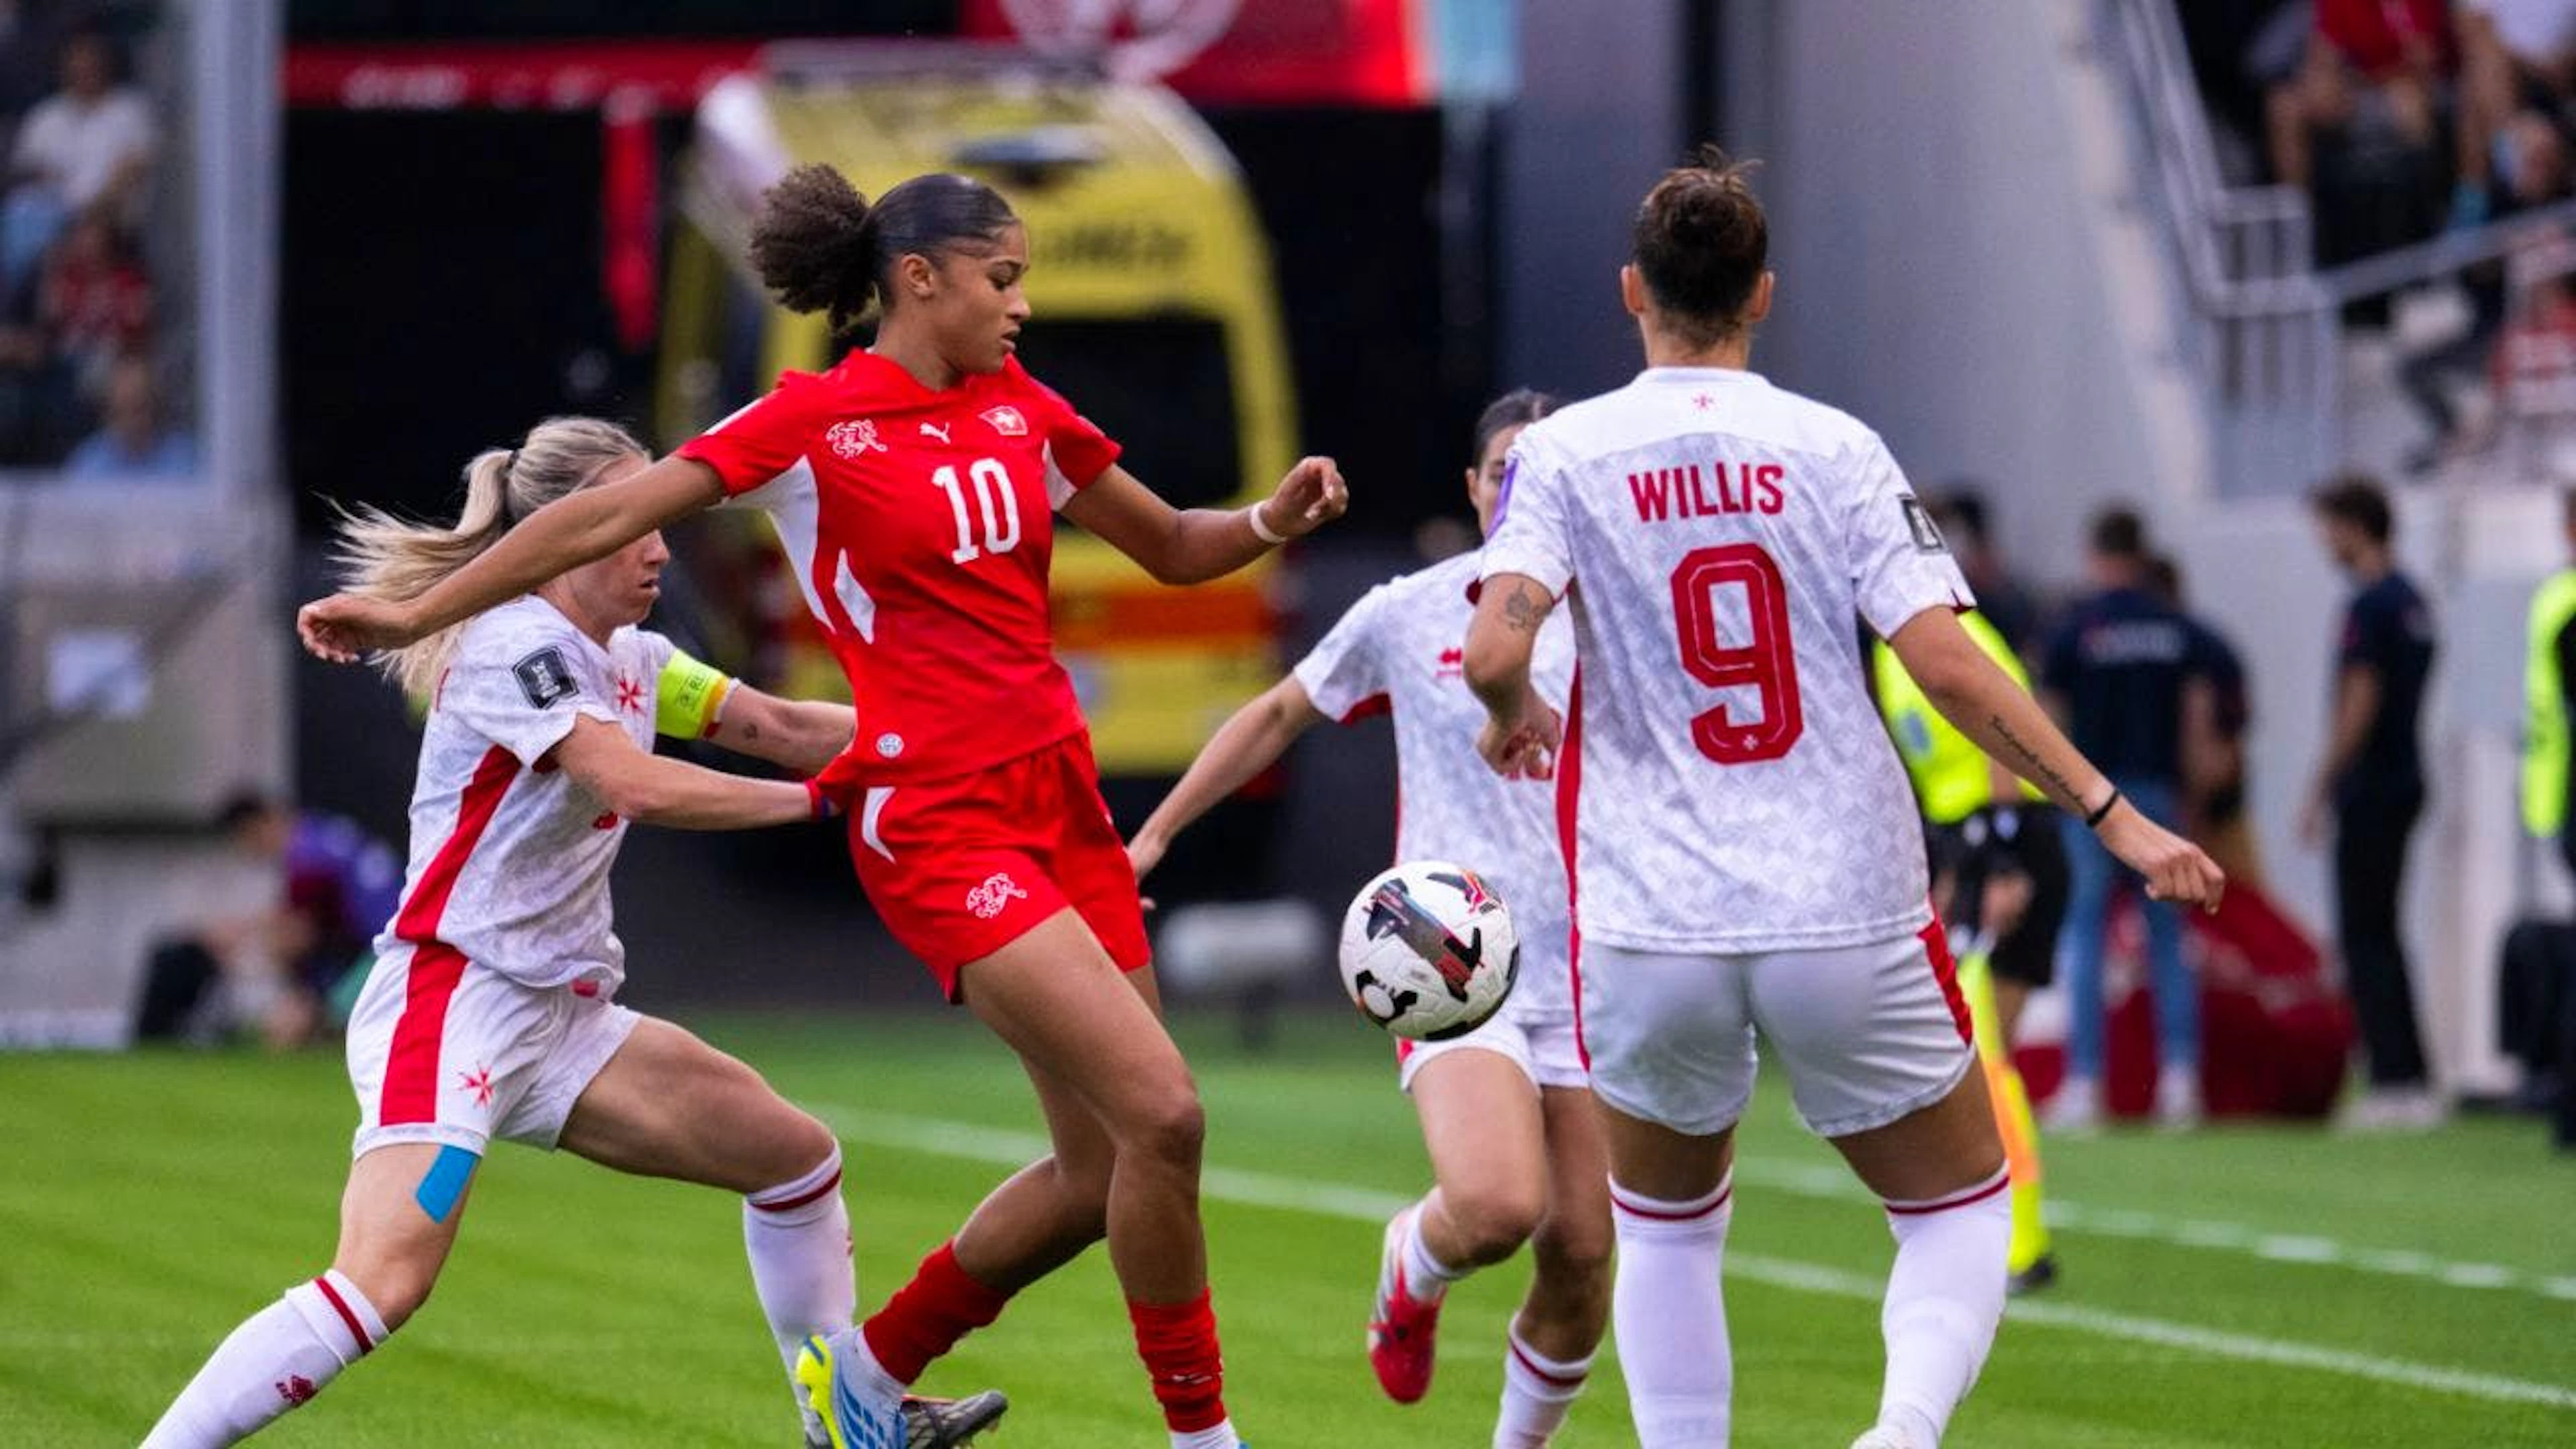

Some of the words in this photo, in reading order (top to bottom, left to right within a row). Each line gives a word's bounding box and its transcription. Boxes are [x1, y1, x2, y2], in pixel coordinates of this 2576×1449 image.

[932, 458, 1020, 564] 10
[1627, 462, 1784, 523] WILLIS
[1670, 542, 1804, 765] 9
